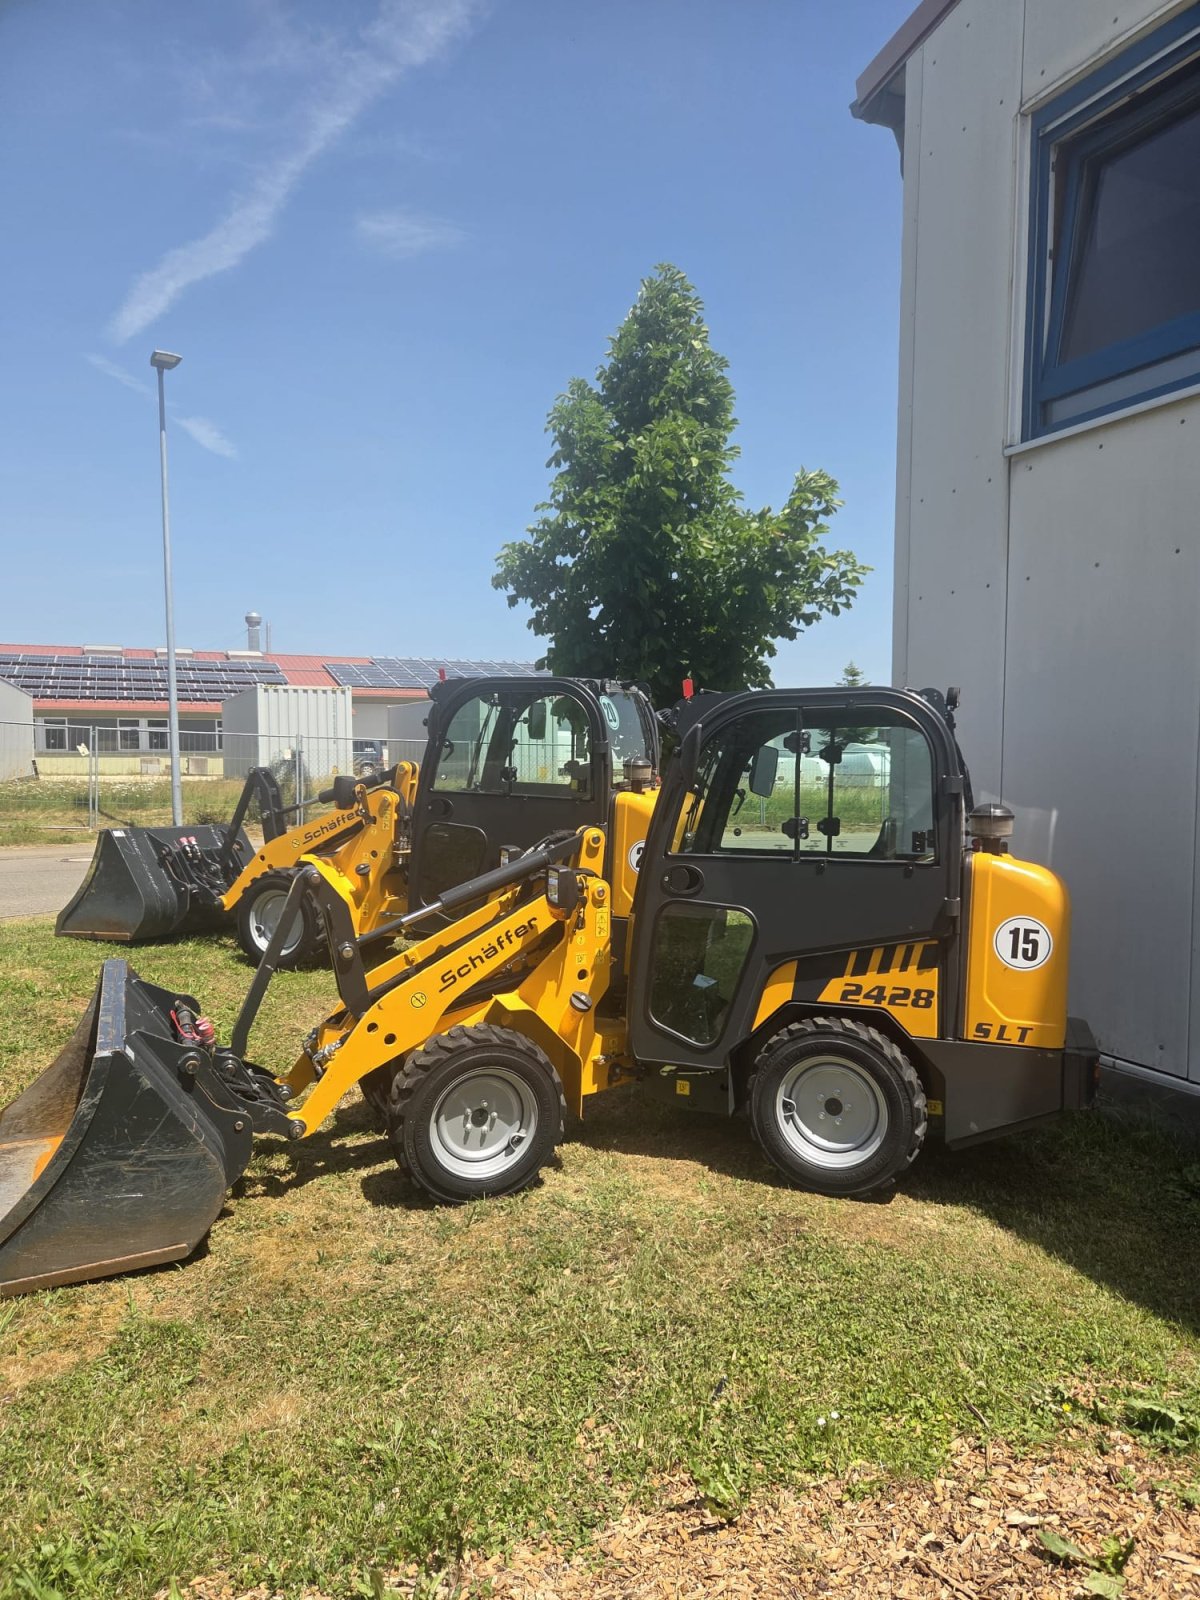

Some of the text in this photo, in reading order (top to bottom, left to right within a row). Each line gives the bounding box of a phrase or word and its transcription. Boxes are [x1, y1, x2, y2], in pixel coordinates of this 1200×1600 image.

[602, 702, 617, 723] 20
[439, 917, 537, 993] Schäffer
[1009, 927, 1040, 961] 15
[840, 983, 935, 1008] 2428
[973, 1022, 1034, 1043] SLT
